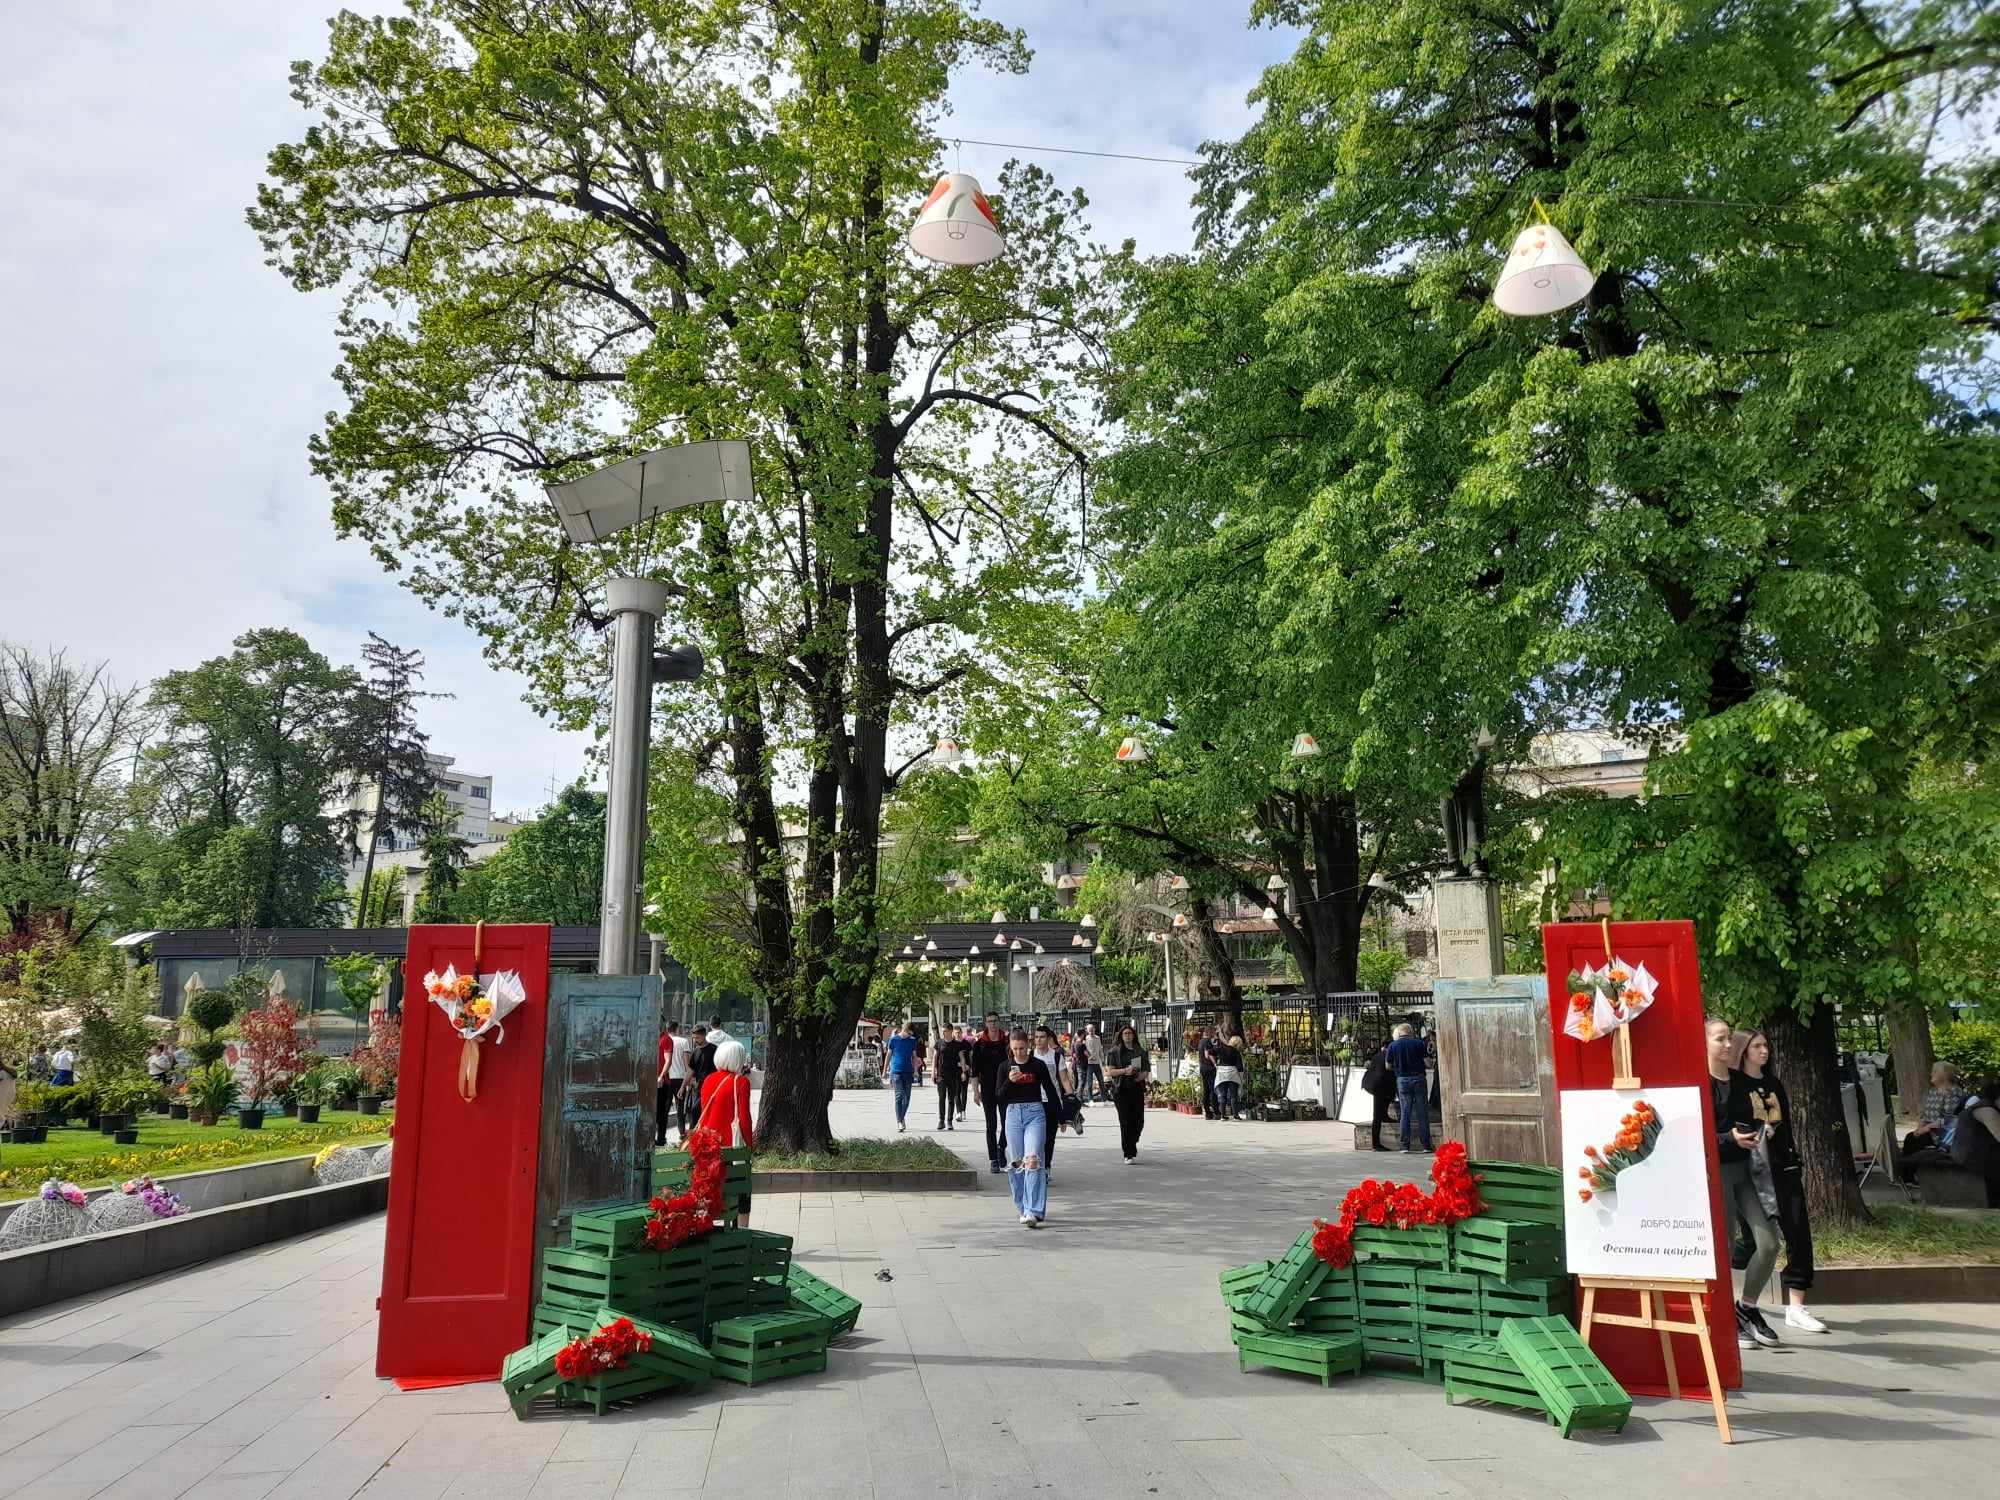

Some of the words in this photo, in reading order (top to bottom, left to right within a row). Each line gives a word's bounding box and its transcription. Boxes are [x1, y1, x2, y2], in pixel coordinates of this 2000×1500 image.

[1640, 1218, 1671, 1229] ДОБРО
[1672, 1219, 1705, 1230] ДОШЛИ
[1603, 1243, 1660, 1255] Фестивал
[1663, 1244, 1707, 1257] цвијећа
